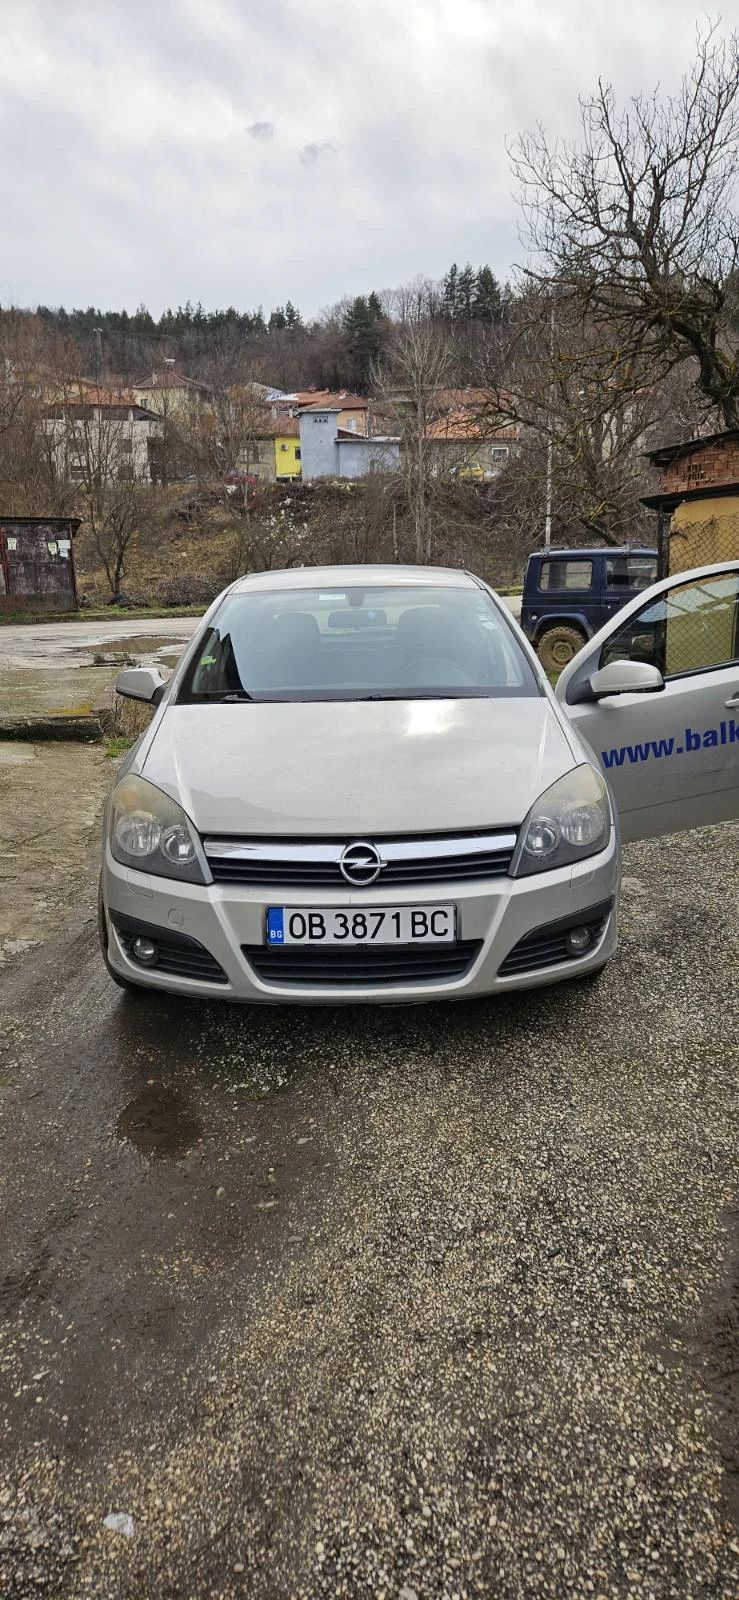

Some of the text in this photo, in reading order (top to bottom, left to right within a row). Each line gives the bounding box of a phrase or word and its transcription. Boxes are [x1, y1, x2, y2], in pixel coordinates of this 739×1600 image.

[270, 930, 283, 939] BG
[288, 910, 449, 940] OB 3871 BC
